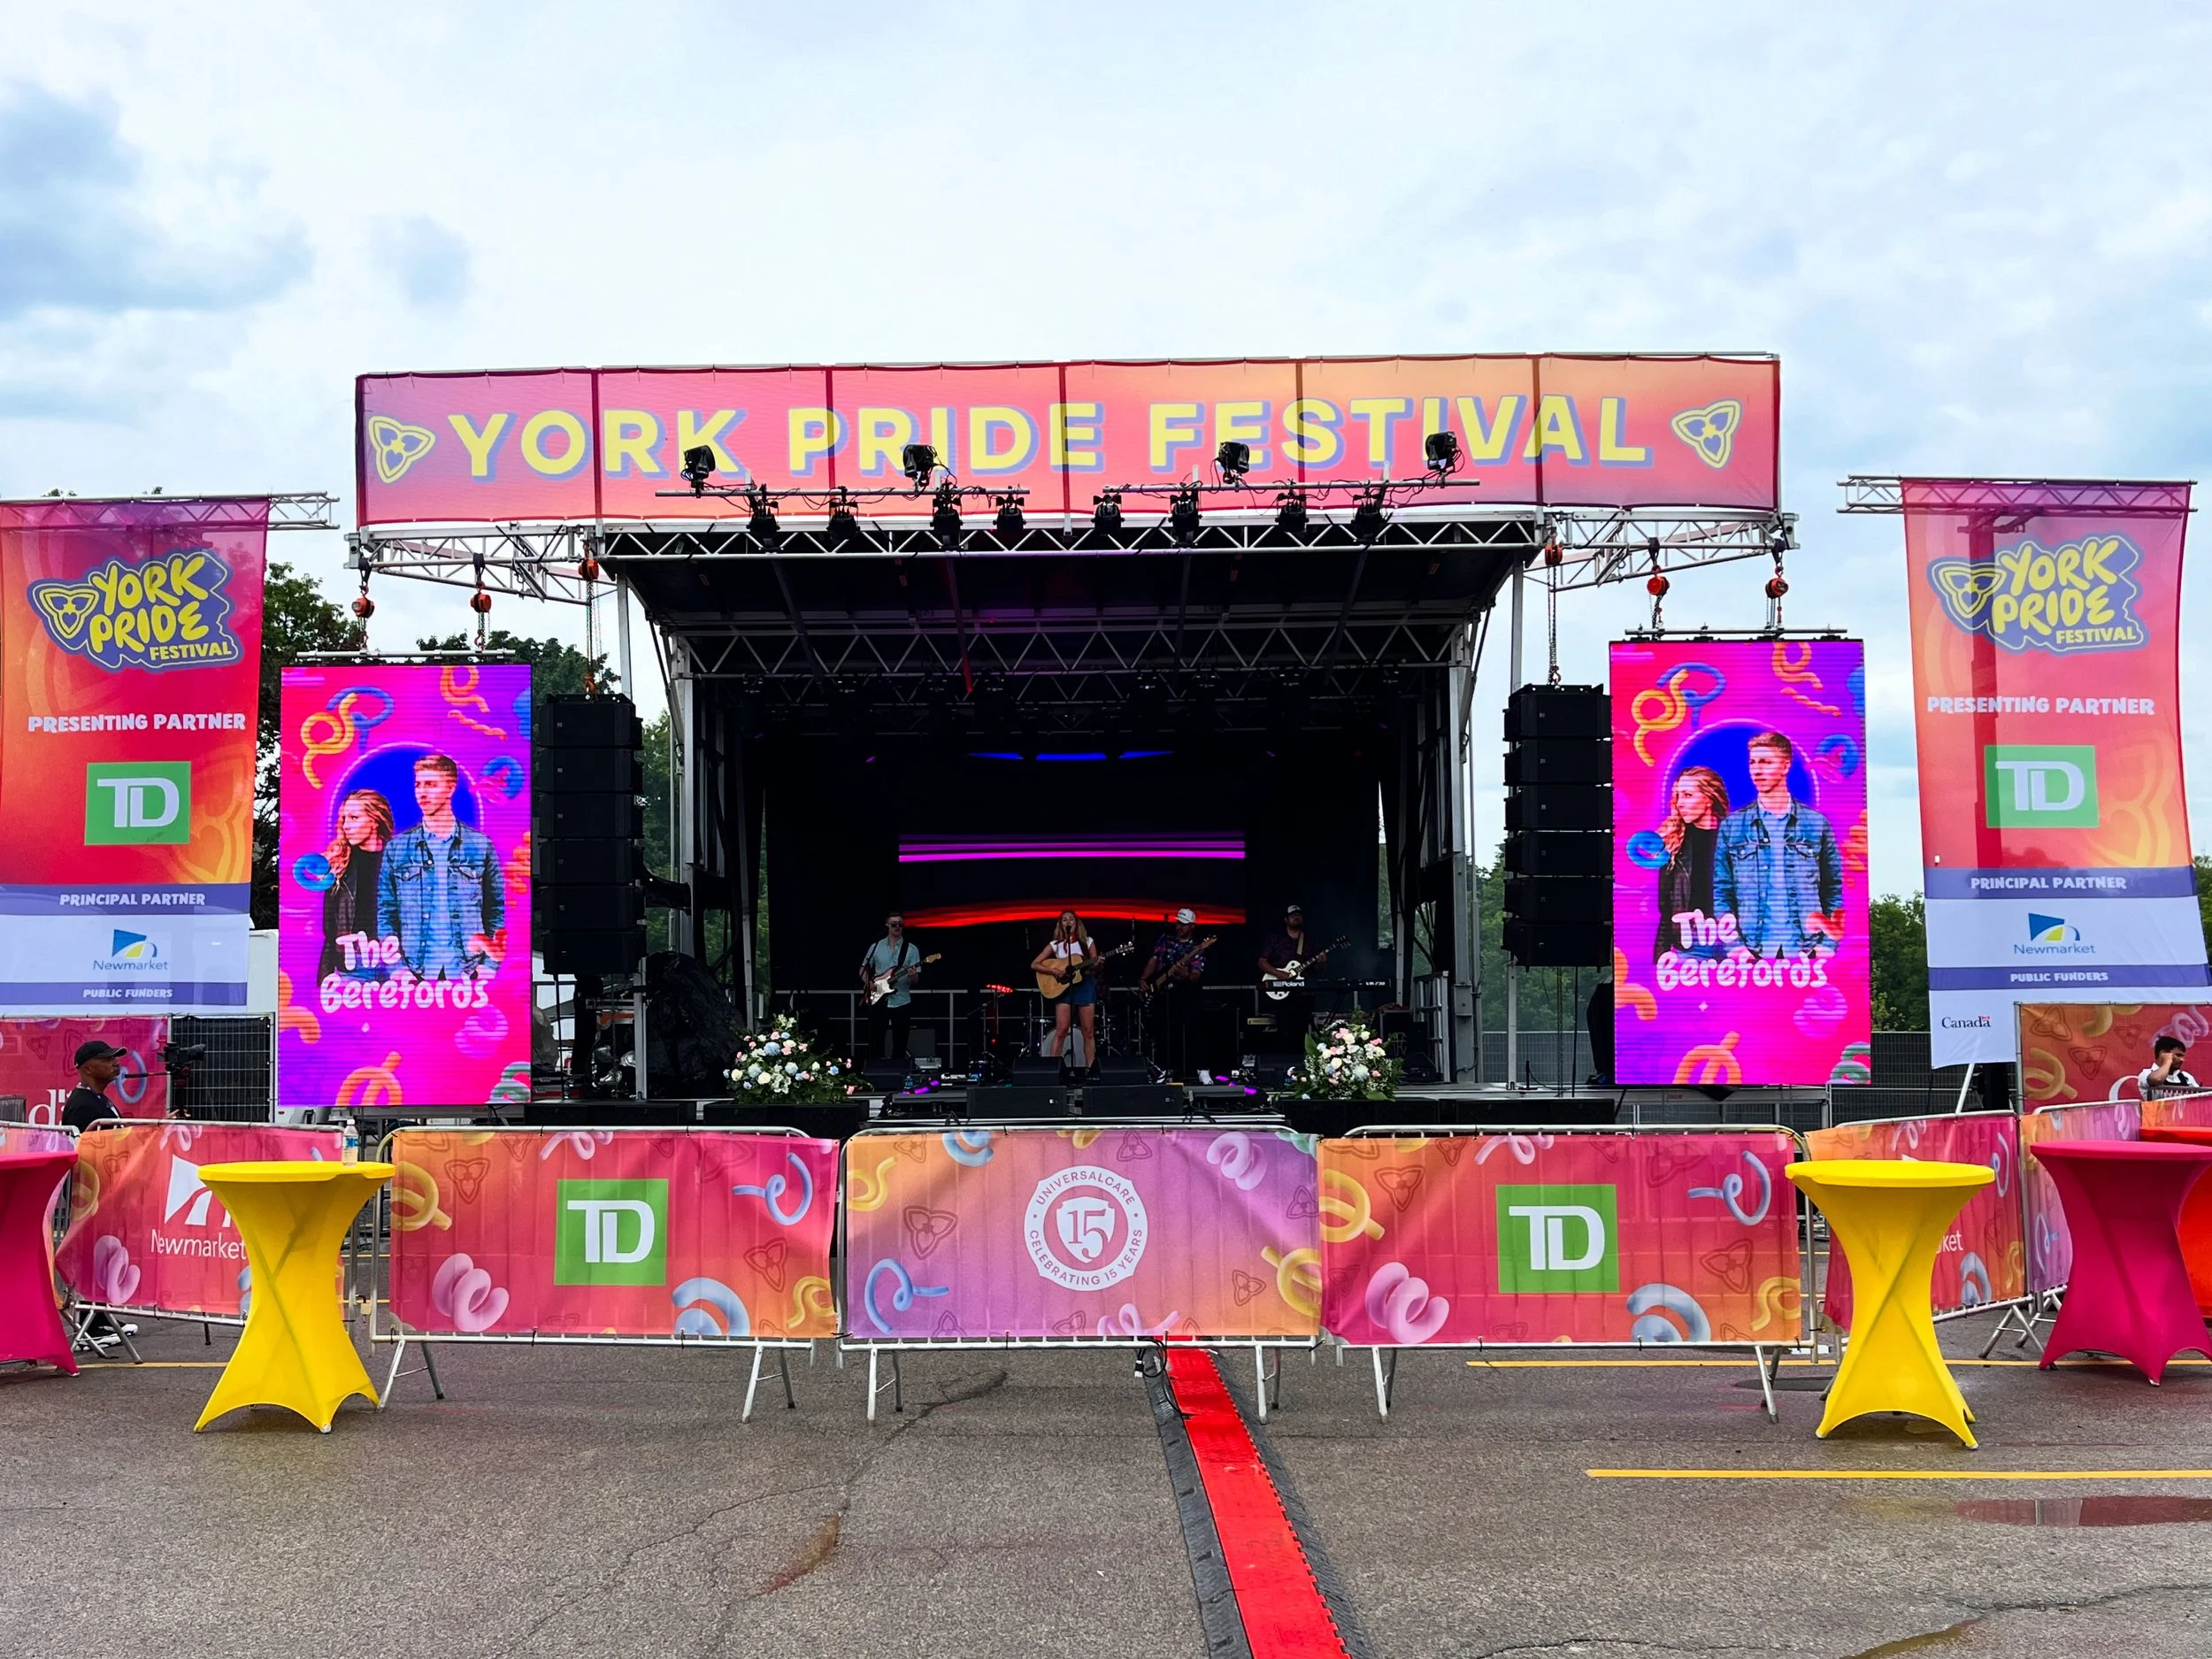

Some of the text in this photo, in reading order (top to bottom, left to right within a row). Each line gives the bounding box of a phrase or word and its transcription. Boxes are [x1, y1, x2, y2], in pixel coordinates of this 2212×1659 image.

[448, 395, 1654, 481] YORK PRIDE FESTIVAL
[90, 557, 209, 616] YORK
[1999, 540, 2119, 596] YORK
[89, 601, 209, 653] PRIDE
[1992, 585, 2115, 635] PRIDE
[150, 641, 232, 661] FESTIVAL
[2056, 626, 2137, 645] FESTIVAL
[27, 712, 246, 733] PRESENTING PARTNER
[1927, 695, 2156, 716] PRESENTING PARTNER
[96, 777, 180, 827] TD
[1995, 761, 2085, 810] TD
[59, 893, 206, 907] PRINCIPAL PARTNER
[1970, 876, 2127, 890] PRINCIPAL PARTNER
[1671, 908, 1740, 949] The
[92, 959, 169, 972] Newmarket
[335, 931, 402, 971] The
[2013, 943, 2096, 955] Newmarket
[1656, 950, 1828, 992] Berefords
[2010, 972, 2108, 983] PUBLIC FUNDERS
[83, 988, 173, 998] PUBLIC FUNDERS
[319, 970, 489, 1013] Berefords
[1941, 1015, 1991, 1029] Canada
[1035, 1171, 1135, 1206] UNIVERSALCARE
[150, 1228, 247, 1260] Newmarket
[567, 1200, 655, 1263] TD
[1067, 1209, 1109, 1260] 15
[1509, 1205, 1606, 1271] TD
[1029, 1229, 1143, 1286] CELEBRATING 15 YEARS
